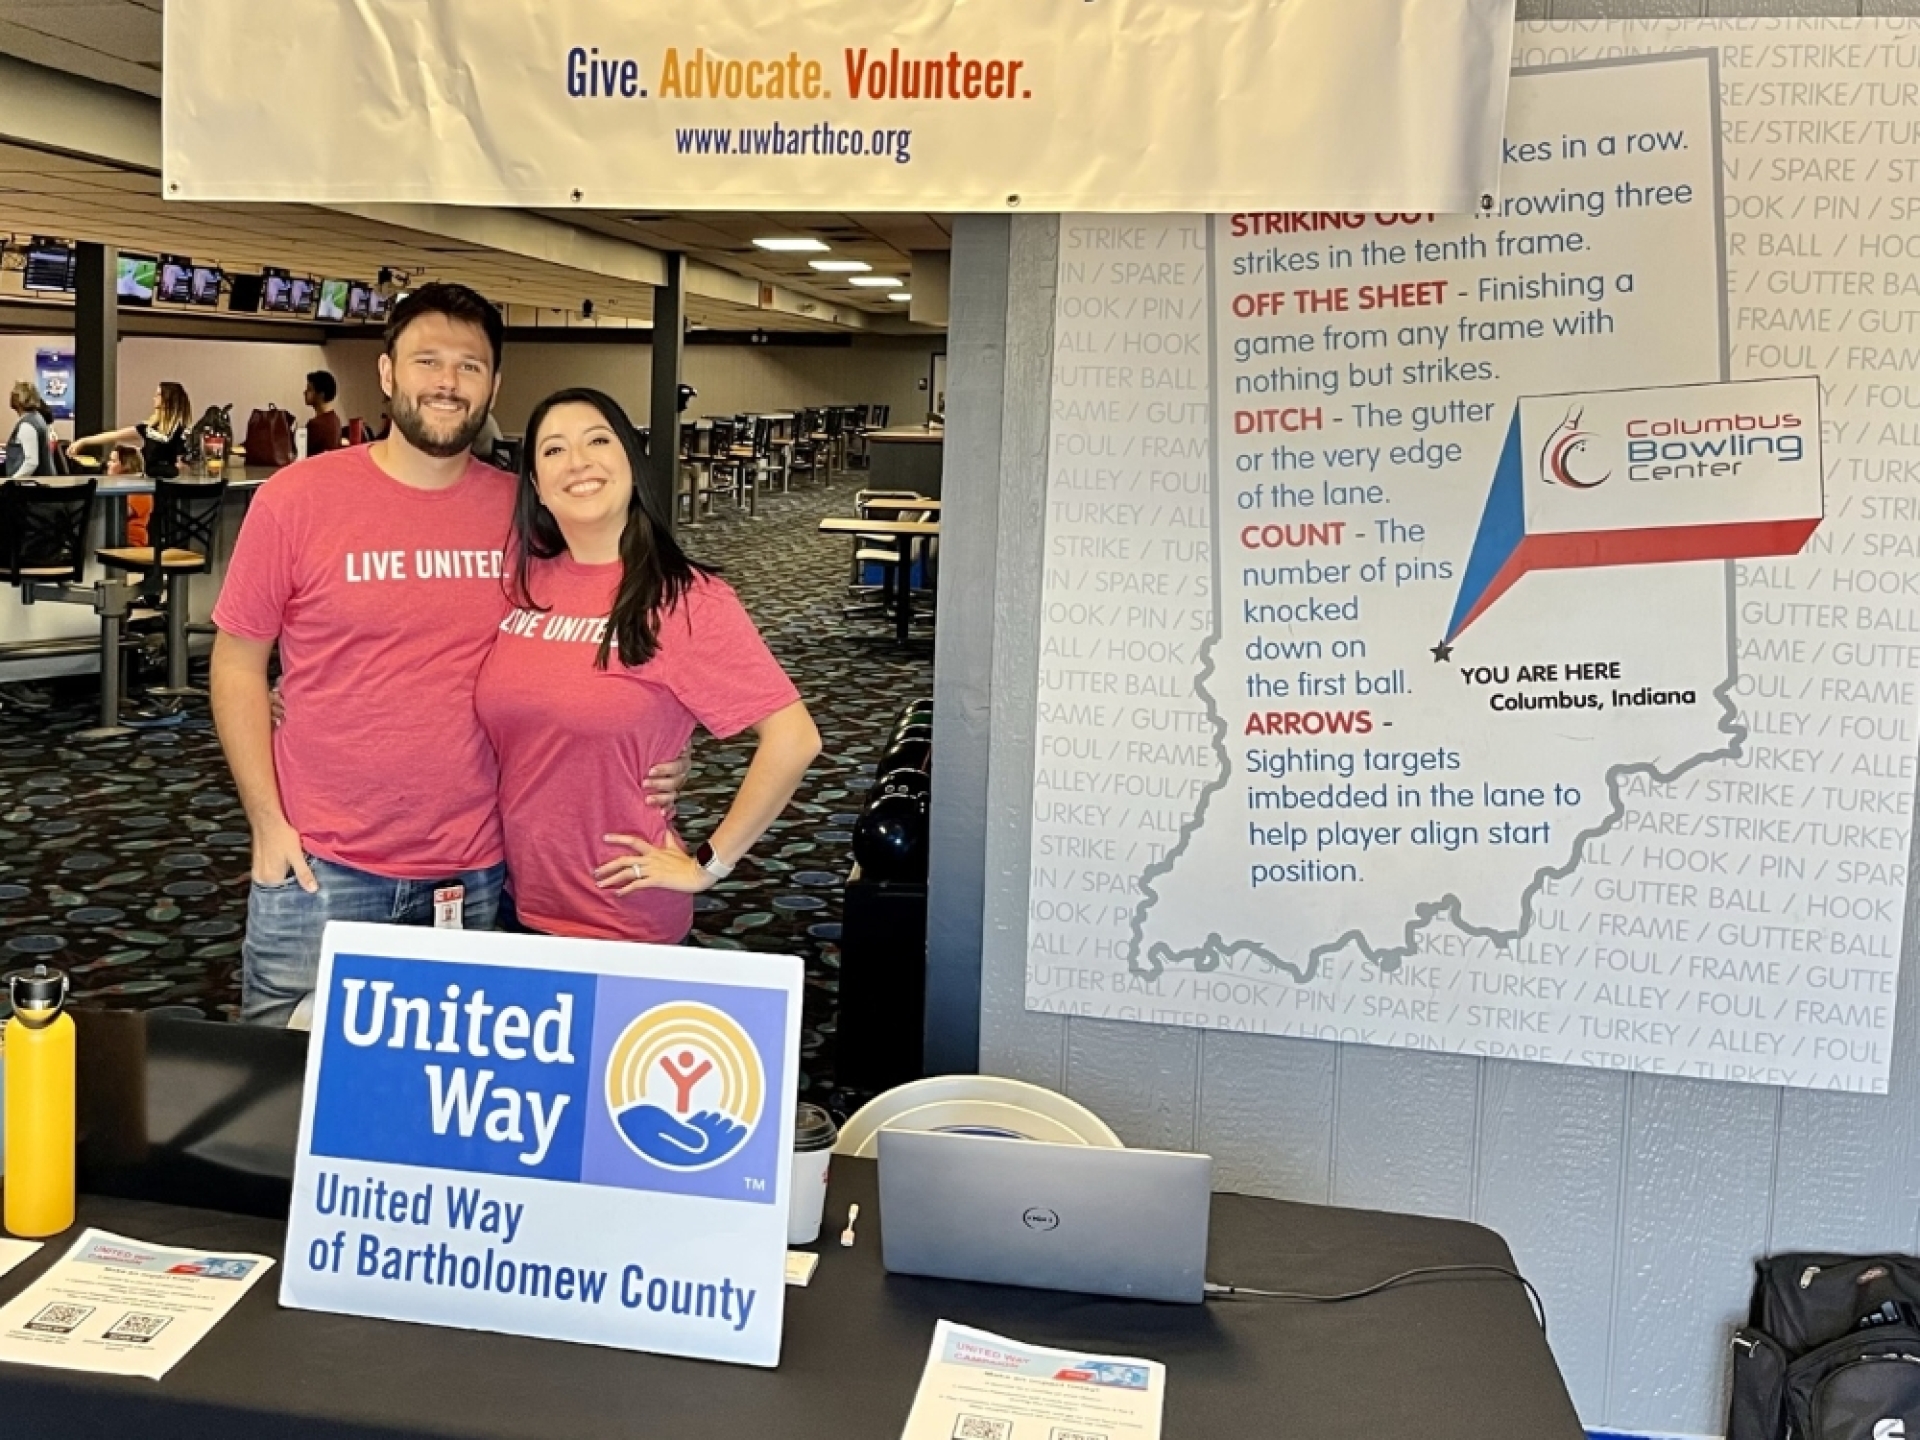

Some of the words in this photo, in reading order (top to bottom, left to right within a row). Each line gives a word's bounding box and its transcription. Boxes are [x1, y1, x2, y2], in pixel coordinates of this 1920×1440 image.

[567, 47, 648, 100] Give.
[659, 47, 832, 100] Advocate.
[845, 47, 1032, 100] Volunteer.
[675, 121, 912, 163] www.uwbarthco.org
[1502, 138, 1552, 164] kes
[1562, 134, 1586, 160] in
[1597, 136, 1615, 156] a
[1626, 130, 1688, 154] row.
[1772, 159, 1856, 182] SPARE
[1231, 213, 1366, 237] STRIKING
[1474, 187, 1605, 218] rowing
[1615, 181, 1693, 208] three
[1814, 196, 1859, 219] PIN
[1068, 227, 1146, 250] STRIKE
[1758, 233, 1822, 257] BALL
[1232, 244, 1320, 275] strikes
[1329, 245, 1352, 269] in
[1361, 241, 1406, 267] the
[1415, 233, 1487, 262] tenth
[1497, 230, 1590, 258] frame.
[1110, 262, 1186, 285] SPARE
[1767, 270, 1874, 295] GUTTER
[1232, 292, 1285, 318] OFF
[1294, 287, 1349, 314] THE
[1359, 280, 1448, 310] SHEET
[1479, 272, 1604, 301] Finishing
[1615, 273, 1634, 293] a
[1143, 298, 1184, 320] PIN
[1737, 307, 1831, 332] FRAME
[1123, 332, 1201, 355] HOOK
[1234, 333, 1314, 363] game
[1323, 324, 1387, 351] from
[1398, 324, 1449, 350] any
[1459, 317, 1544, 343] frame
[1552, 308, 1614, 337] with
[1746, 345, 1817, 369] FOUL
[1141, 367, 1197, 390] BALL
[1236, 367, 1338, 394] nothing
[1348, 362, 1393, 387] but
[1402, 357, 1500, 385] strikes.
[1052, 400, 1120, 422] RAME
[1234, 407, 1323, 434] DITCH
[1351, 401, 1402, 428] The
[1412, 400, 1494, 432] gutter
[1626, 413, 1802, 439] Columbus
[1055, 434, 1116, 456] FOUL
[1236, 453, 1263, 472] or
[1271, 446, 1314, 471] the
[1323, 447, 1380, 472] very
[1389, 438, 1462, 468] edge
[1628, 434, 1803, 464] Bowling
[1054, 468, 1123, 490] ALLEY
[1629, 459, 1742, 482] Center
[1237, 484, 1264, 509] of
[1271, 483, 1314, 507] the
[1324, 480, 1390, 506] lane.
[1052, 501, 1144, 525] TURKEY
[1053, 535, 1130, 559] STRIKE
[1241, 522, 1346, 549] COUNT
[1374, 518, 1425, 544] The
[345, 550, 406, 582] LIVE
[1243, 559, 1350, 586] number
[1360, 557, 1387, 582] of
[1396, 557, 1453, 587] pins
[1095, 572, 1169, 595] SPARE
[1127, 607, 1166, 628] PIN
[1244, 595, 1358, 623] knocked
[1741, 601, 1848, 628] GUTTER
[499, 608, 545, 638] LIVE
[542, 615, 619, 648] UNITE
[1108, 641, 1184, 665] HOOK
[1245, 635, 1322, 660] down
[1332, 639, 1366, 659] on
[1126, 674, 1181, 697] BALL
[1246, 673, 1289, 697] the
[1298, 671, 1346, 696] first
[1355, 669, 1412, 695] ball.
[1460, 666, 1510, 685] YOU
[1516, 663, 1557, 683] ARE
[1565, 661, 1621, 680] HERE
[1490, 691, 1604, 712] Columbus,
[1612, 688, 1696, 708] Indiana
[1821, 678, 1914, 705] FRAME
[1039, 703, 1104, 726] RAME
[1244, 710, 1373, 736] ARROWS
[1840, 716, 1910, 742] FOUL
[1041, 736, 1102, 760] FOUL
[1127, 741, 1208, 766] FRAME
[1246, 747, 1354, 778] Sighting
[1363, 747, 1461, 777] targets
[1248, 783, 1387, 809] imbedded
[1398, 784, 1420, 807] in
[1430, 783, 1473, 806] the
[1484, 782, 1545, 806] lane
[1553, 783, 1581, 806] to
[1705, 780, 1794, 807] STRIKE
[1822, 787, 1914, 815] TURKE
[1034, 801, 1112, 826] URKEY
[1040, 835, 1117, 860] STRIKE
[1249, 821, 1307, 851] help
[1317, 820, 1402, 850] player
[1410, 820, 1478, 850] align
[1488, 821, 1550, 845] start
[1252, 859, 1364, 888] position.
[1644, 848, 1729, 875] HOOK
[1760, 855, 1806, 879] PIN
[1595, 879, 1697, 907] GUTTER
[1708, 887, 1771, 913] BALL
[1808, 894, 1893, 922] HOOK
[1599, 913, 1690, 942] FRAME
[1718, 923, 1822, 953] GUTTER
[1831, 931, 1893, 959] BALL
[1595, 948, 1662, 976] FOUL
[1689, 955, 1780, 986] FRAME
[1806, 966, 1893, 995] GUTTE
[1469, 971, 1567, 1000] TURKEY
[1594, 982, 1670, 1011] ALLEY
[1698, 992, 1766, 1019] FOUL
[1795, 1000, 1887, 1029] FRAME
[342, 978, 575, 1064] United
[1193, 980, 1269, 1006] HOOK
[1296, 988, 1337, 1014] PIN
[1364, 995, 1440, 1023] SPARE
[1467, 1005, 1550, 1034] STRIKE
[1579, 1015, 1681, 1046] TURKEY
[1708, 1028, 1785, 1056] ALLEY
[1814, 1037, 1882, 1064] FOUL
[424, 1064, 571, 1166] Way
[743, 1177, 765, 1191] TM
[316, 1172, 433, 1226] United
[447, 1185, 524, 1244] Way
[308, 1230, 347, 1272] of
[357, 1234, 608, 1304] Bartholomew
[620, 1264, 756, 1331] County
